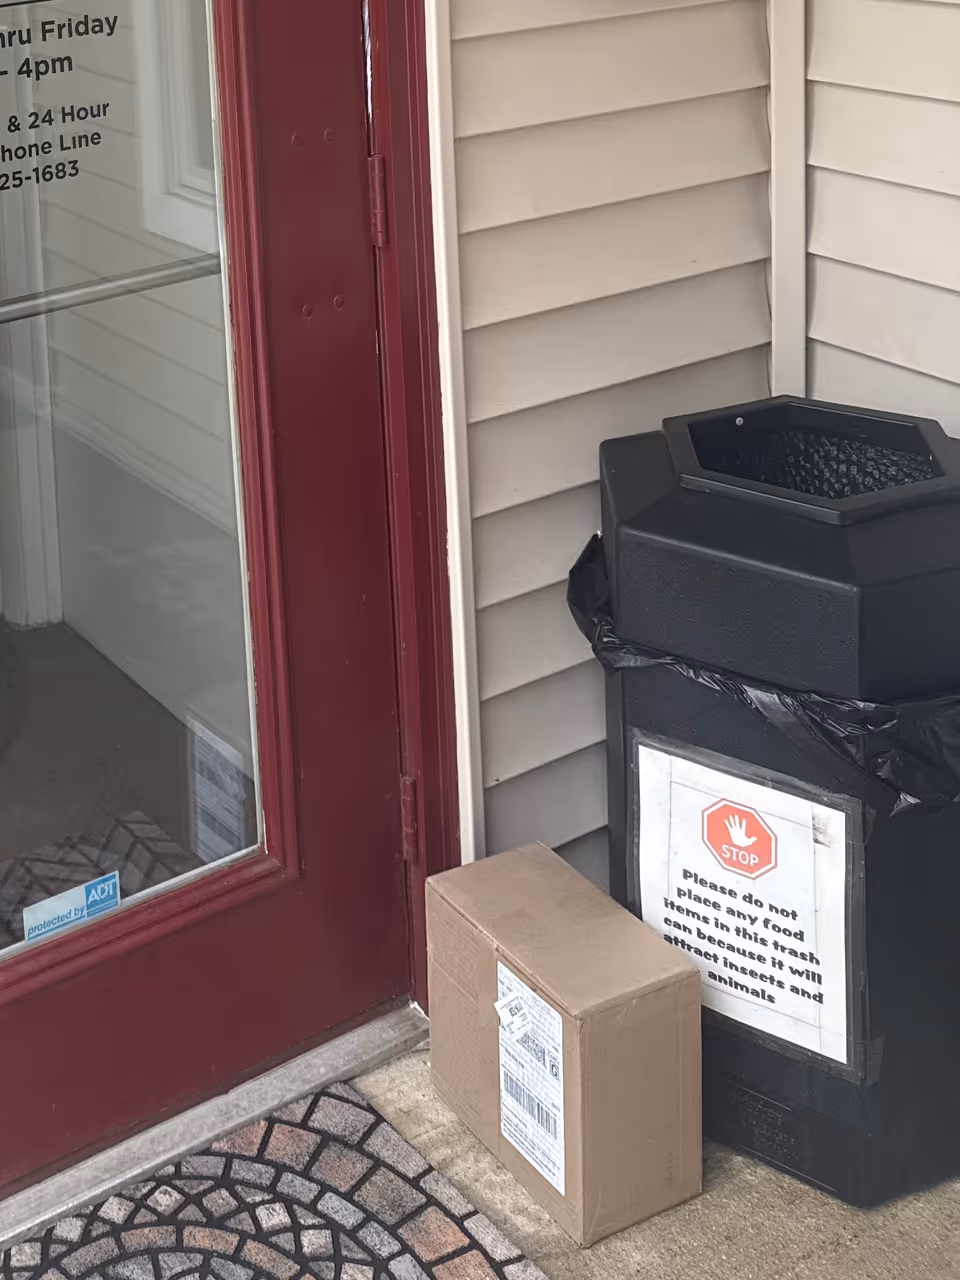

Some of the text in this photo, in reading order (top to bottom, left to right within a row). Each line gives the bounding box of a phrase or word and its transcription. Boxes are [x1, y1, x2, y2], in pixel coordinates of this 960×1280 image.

[41, 12, 119, 42] Friday
[17, 53, 74, 84] 4pm
[7, 115, 21, 133] &
[27, 111, 55, 130] 24
[61, 101, 111, 124] Hour
[59, 129, 102, 152] Line
[721, 844, 760, 866] STOP
[87, 881, 116, 905] ADT
[682, 868, 799, 921] Please do not
[27, 904, 85, 937] protected by
[676, 886, 805, 942] place any food
[663, 897, 821, 966] items in this trash
[663, 916, 823, 986] can because it will
[663, 933, 824, 1005] attract insects and
[707, 970, 776, 1004] animals
[551, 1063, 558, 1078] G
